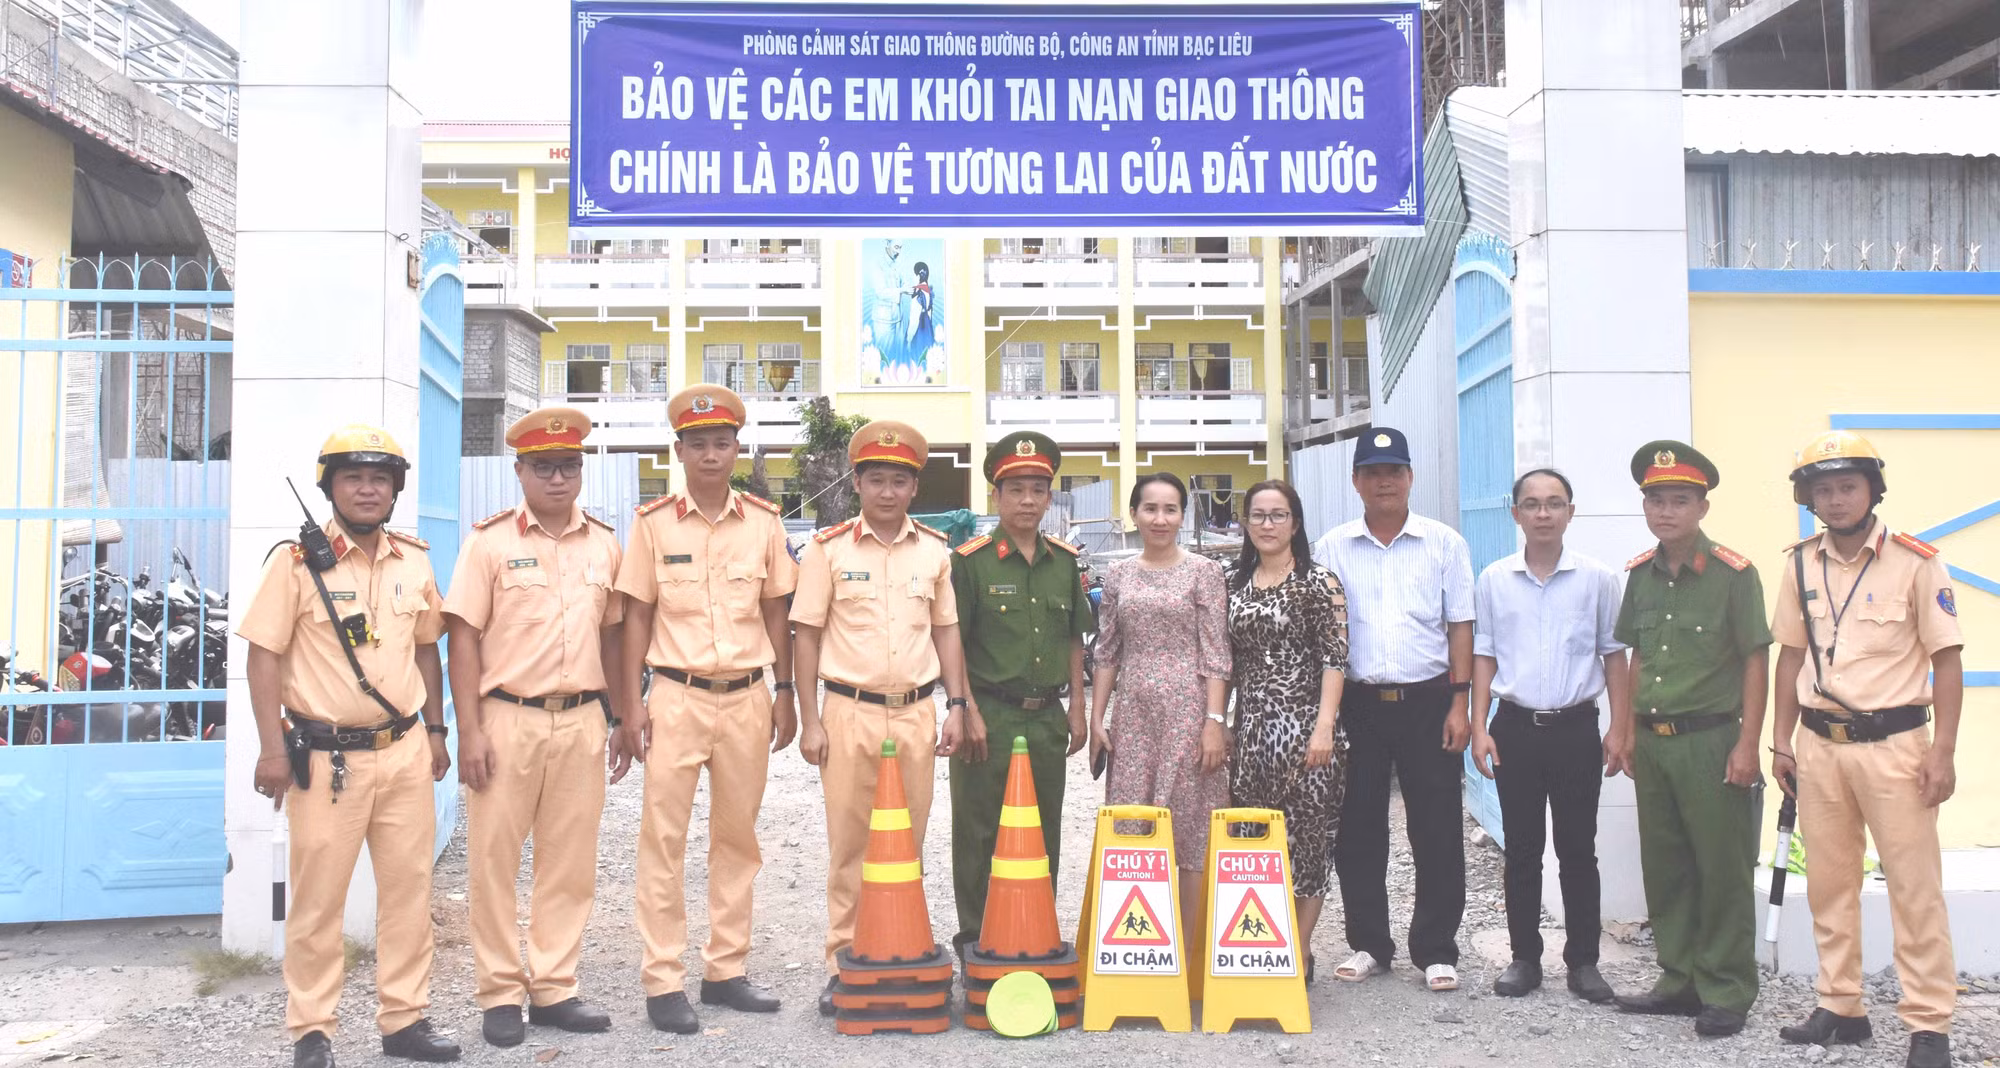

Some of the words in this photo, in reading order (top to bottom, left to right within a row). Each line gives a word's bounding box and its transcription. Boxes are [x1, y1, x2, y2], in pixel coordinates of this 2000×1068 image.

[743, 30, 798, 56] PHÒNG
[802, 28, 846, 56] CẢNH
[850, 31, 880, 56] SÁT
[884, 35, 921, 56] GIAO
[925, 32, 977, 56] THÔNG
[981, 31, 1035, 56] ĐƯỜNG
[1039, 32, 1065, 61] BỘ,
[1069, 32, 1112, 56] CÔNG
[1116, 36, 1139, 56] AN
[1143, 29, 1179, 56] TỈNH
[1183, 36, 1214, 60] BẠC
[1219, 32, 1252, 56] LIÊU
[622, 61, 694, 121] BẢO
[706, 68, 749, 131] VỆ
[761, 68, 832, 121] CÁC
[845, 78, 899, 121] EM
[911, 63, 994, 122] KHỎI
[1005, 78, 1056, 122] TAI
[1068, 78, 1143, 131] NẠN
[1155, 77, 1236, 122] GIAO
[1247, 68, 1364, 121] THÔNG
[609, 141, 721, 194] CHÍNH
[733, 141, 777, 194] LÀ
[788, 137, 860, 195] BẢO
[871, 142, 914, 204] VỆ
[925, 147, 1043, 195] TƯƠNG
[1055, 152, 1109, 194] LAI
[1120, 136, 1192, 195] CỦA
[1201, 135, 1269, 194] ĐẤT
[1280, 140, 1377, 194] NƯỚC
[1106, 851, 1141, 870] CHÚ
[1220, 854, 1256, 872] CHÚ
[1100, 952, 1117, 966] ĐI
[1123, 949, 1174, 970] CHẬM
[1217, 954, 1234, 968] ĐI
[1240, 951, 1291, 972] CHẬM
